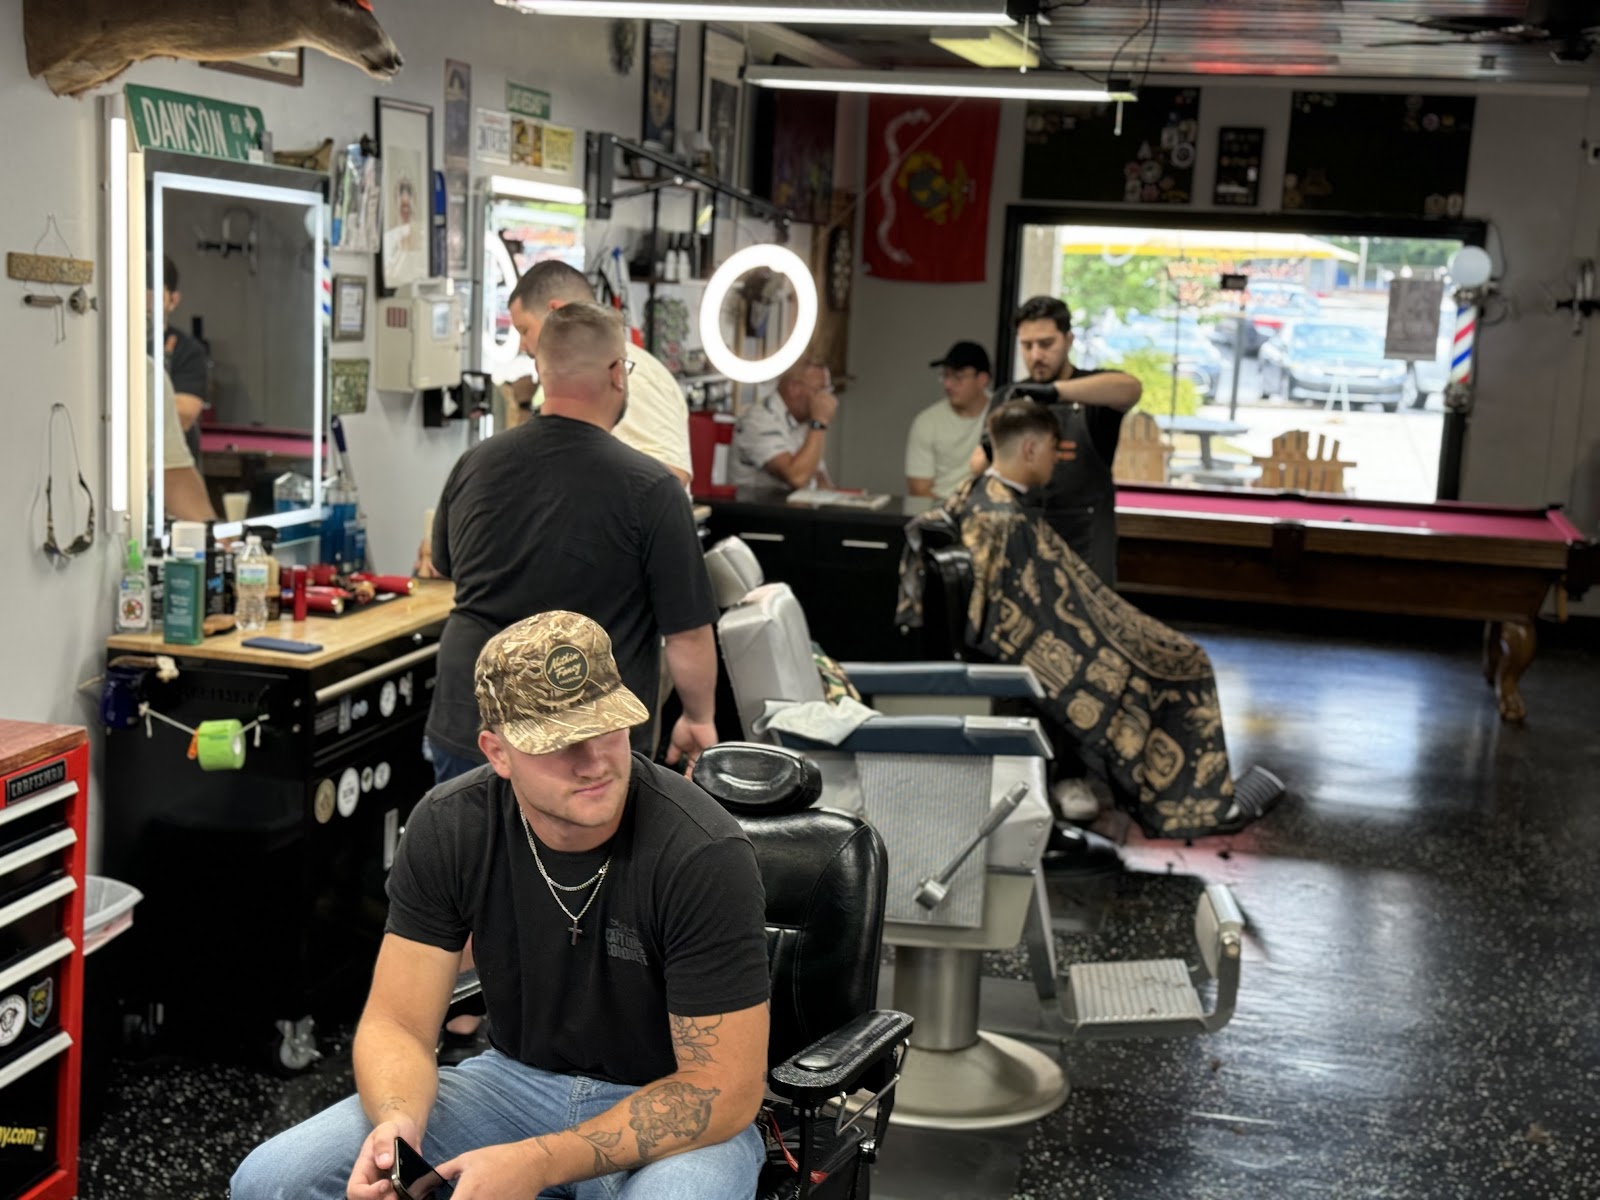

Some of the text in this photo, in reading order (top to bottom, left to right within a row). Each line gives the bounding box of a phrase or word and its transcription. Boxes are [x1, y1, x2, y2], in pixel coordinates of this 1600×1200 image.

[140, 96, 229, 158] DAWSON
[547, 652, 580, 675] Nothin
[554, 663, 582, 680] Fancy
[10, 764, 64, 798] CRAFTSMAN
[0, 1125, 37, 1149] y.com
